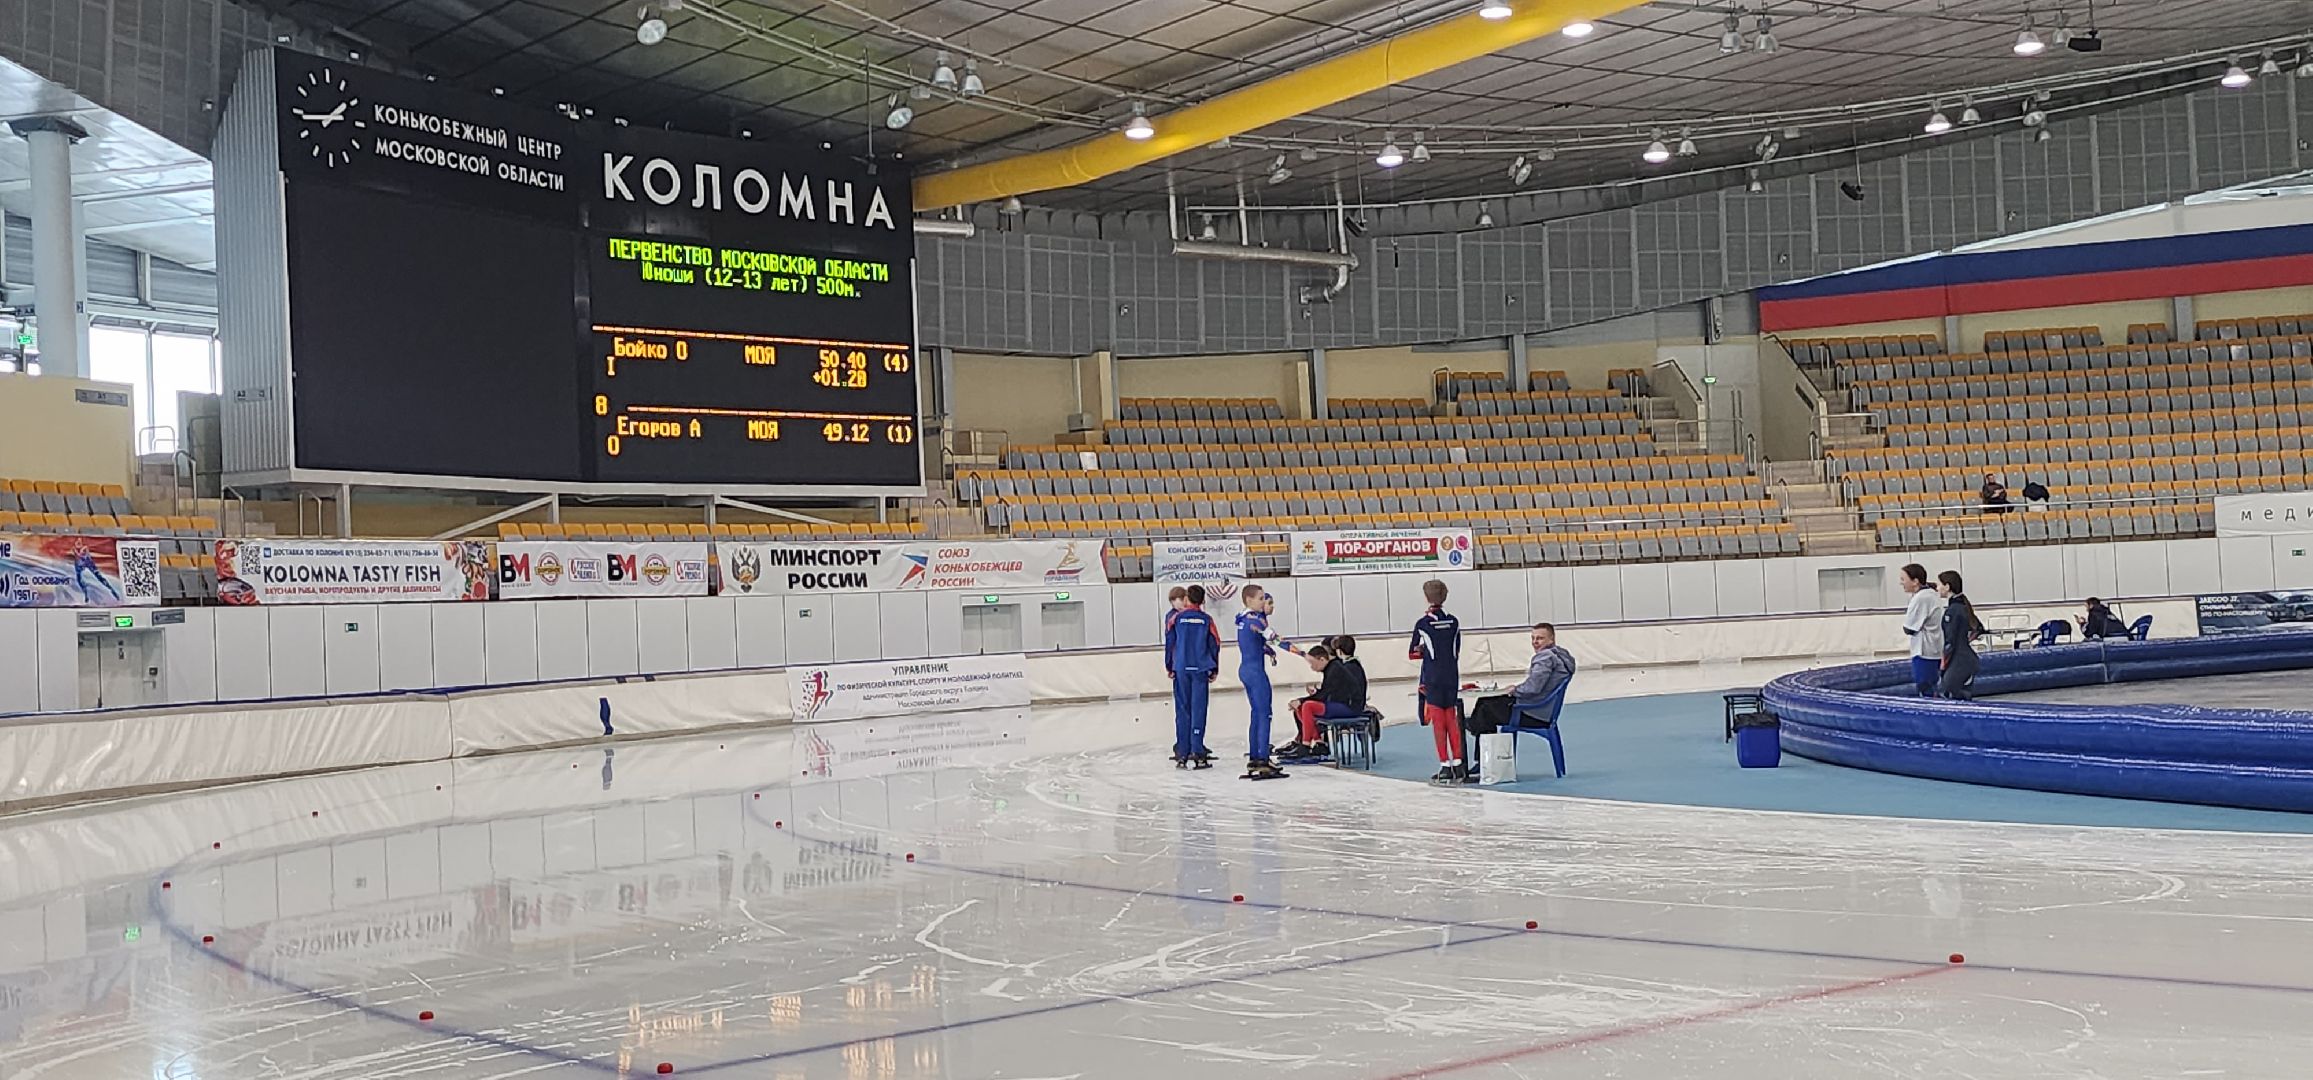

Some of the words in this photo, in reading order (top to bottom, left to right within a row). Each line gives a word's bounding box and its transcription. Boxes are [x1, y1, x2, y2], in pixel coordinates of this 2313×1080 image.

[374, 104, 508, 149] КОНЬКОБЕЖНЫЙ
[518, 135, 562, 161] ЦЕНТР
[375, 137, 490, 176] МОСКОВСКОЙ
[498, 162, 564, 191] ОБЛАСТИ
[603, 152, 896, 230] КОЛОМНА
[609, 238, 713, 266] ПЕРВЕНСТВО
[721, 249, 817, 275] МОСКОВСКОЙ
[824, 259, 889, 282] ОБЛАСТИ
[642, 261, 694, 284] Юноши
[705, 267, 762, 290] (12-13
[770, 275, 808, 293] лет)
[816, 276, 862, 298] 500м.
[614, 337, 668, 359] Бойко
[744, 344, 776, 365] МОЯ
[819, 349, 867, 369] 50.40
[883, 352, 909, 372] (4)
[595, 395, 608, 416] 8
[617, 415, 681, 438] Егоров
[747, 420, 779, 440] МОЯ
[823, 423, 870, 442] 49.12
[887, 424, 913, 443] (1)
[938, 548, 971, 559] СОЮЗ
[1333, 540, 1431, 555] ЛОР-ОРГАНОВ
[769, 548, 882, 567] МИНСПОРТ
[934, 560, 1023, 574] КОНЬКОБЕЖЦЕВ
[14, 575, 28, 586] Год
[263, 565, 350, 583] KOLOMNA
[352, 565, 400, 582] TASTY
[405, 565, 441, 582] FISH
[788, 572, 868, 590] РОССИИ
[931, 576, 975, 588] РОССИИ
[892, 663, 949, 676] УПРАВЛЕНИЕ
